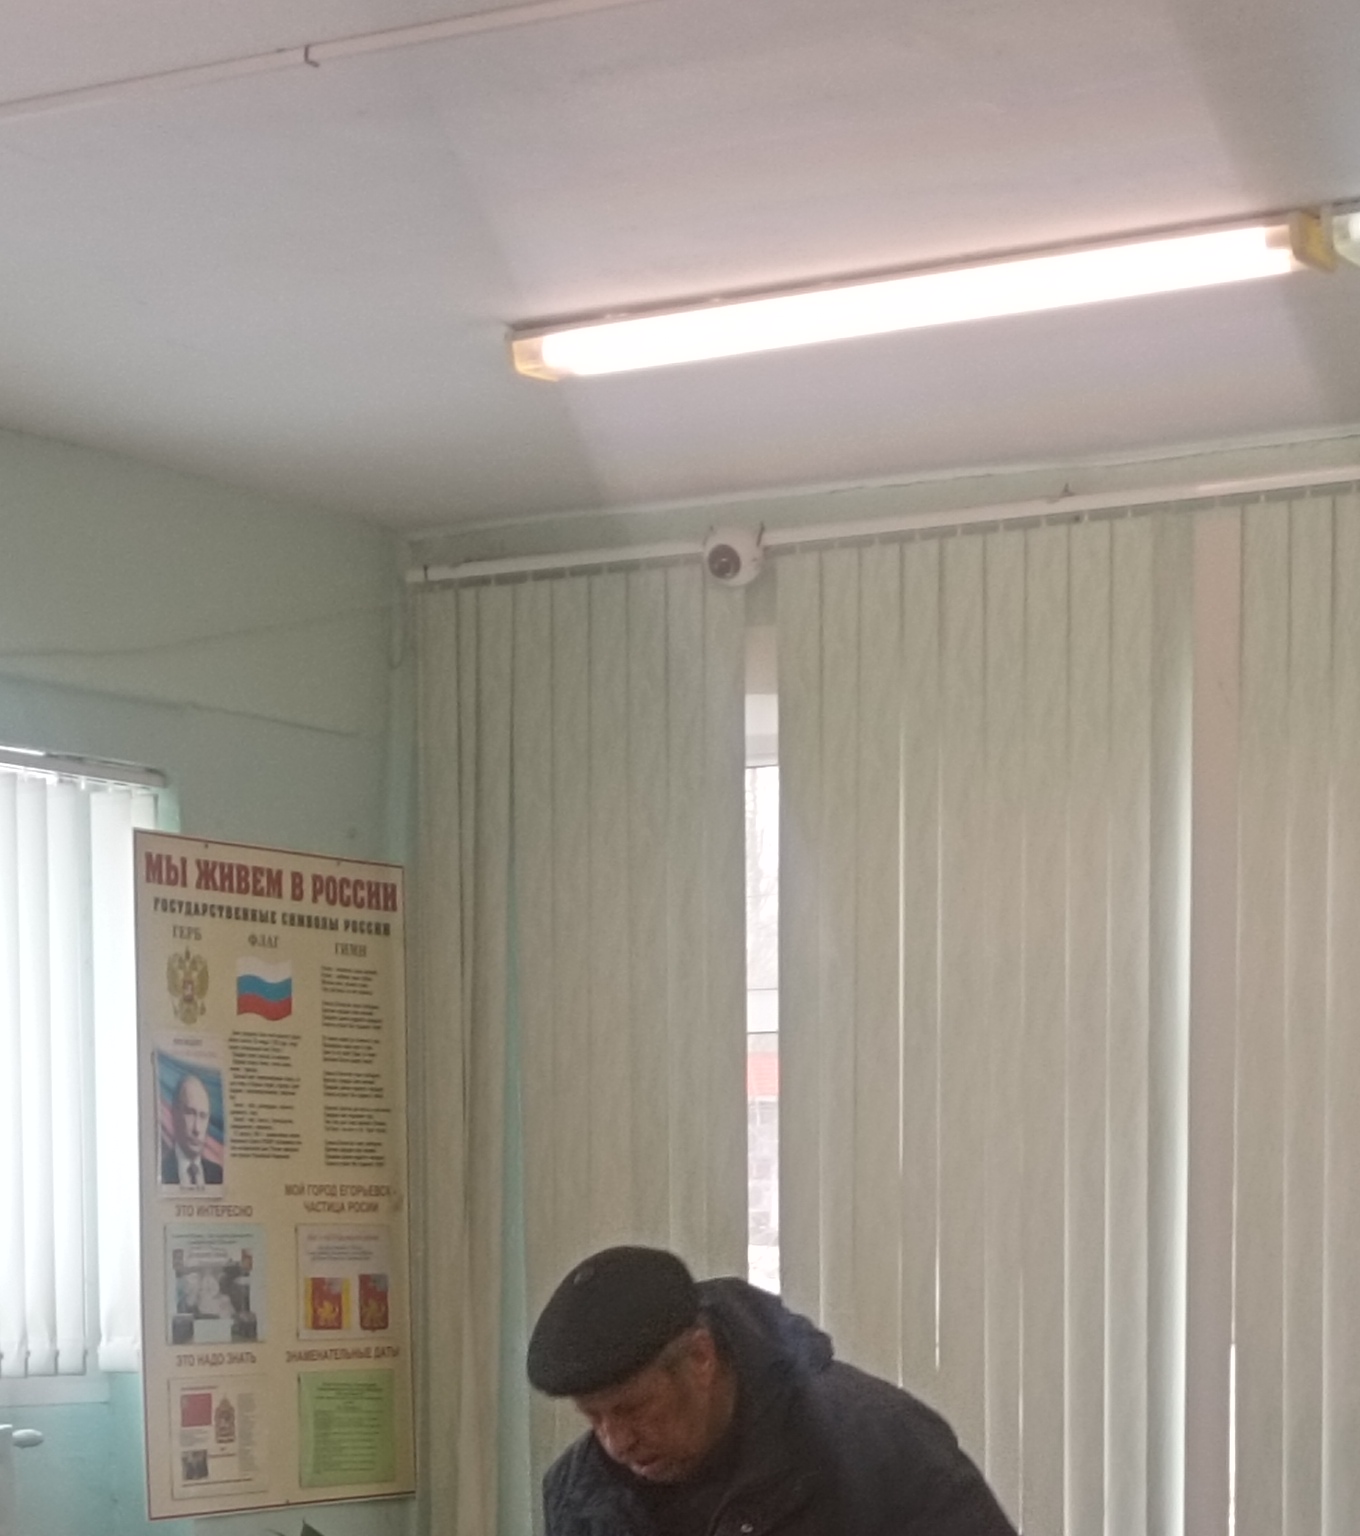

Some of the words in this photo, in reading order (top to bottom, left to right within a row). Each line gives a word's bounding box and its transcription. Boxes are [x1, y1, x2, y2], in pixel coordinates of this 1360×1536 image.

[144, 851, 188, 888] МЫ
[195, 858, 283, 899] ЖИВЕМ
[291, 870, 304, 902] В
[312, 873, 398, 912] РОССИИ
[153, 896, 276, 924] ГОСУДАРСТВЕННЫЕ
[281, 912, 339, 932] СИМВОЛЫ
[344, 920, 391, 937] РОССИИ
[172, 924, 202, 941] ГЕРБ
[248, 932, 280, 949] ФЛАГ
[334, 941, 368, 957] ГИМН
[284, 1182, 306, 1196] МОЙ
[307, 1184, 337, 1198] ГОРОД
[175, 1204, 195, 1217] ЭТО
[196, 1204, 253, 1217] ИНТЕРЕСНО
[303, 1200, 345, 1214] ЧАСТИЦА
[176, 1354, 194, 1367] ЭТО
[197, 1353, 224, 1367] НАДО
[227, 1351, 257, 1365] ЗНАТЬ
[285, 1348, 371, 1364] ЗНАМЕНАТЕЛЬНЫЕ
[374, 1345, 400, 1360] ДАТЫ
